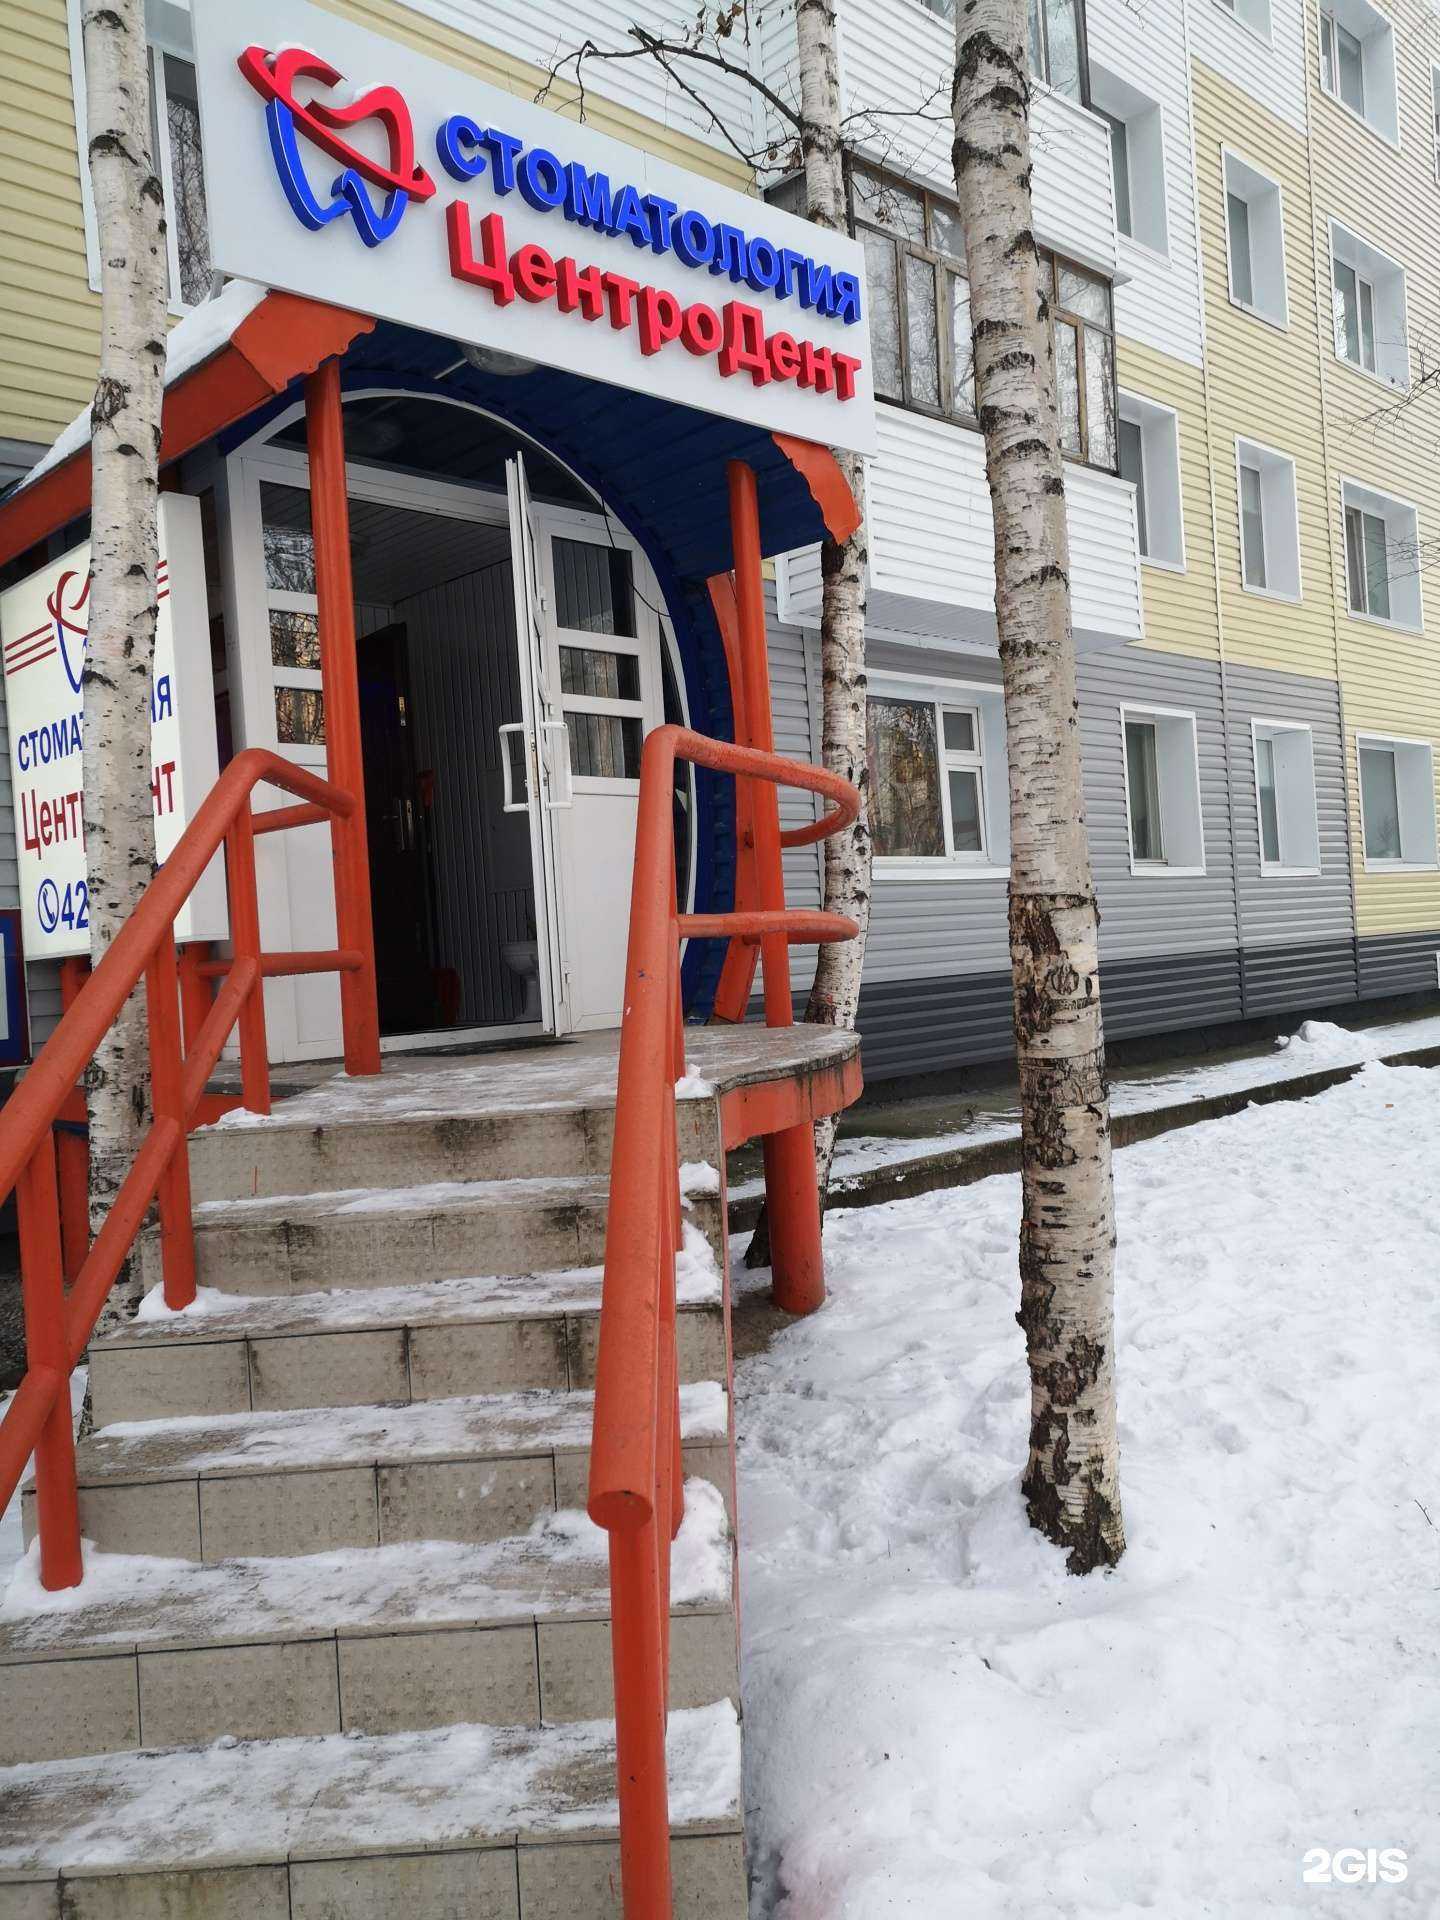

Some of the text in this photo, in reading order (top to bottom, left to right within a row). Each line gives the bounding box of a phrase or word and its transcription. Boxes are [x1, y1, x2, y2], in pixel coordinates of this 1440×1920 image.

[436, 115, 862, 325] СТОМАТОЛОГИЯ
[445, 200, 862, 401] ЦентроДент
[18, 674, 172, 771] СТОМАЯ
[22, 761, 175, 860] Центнт
